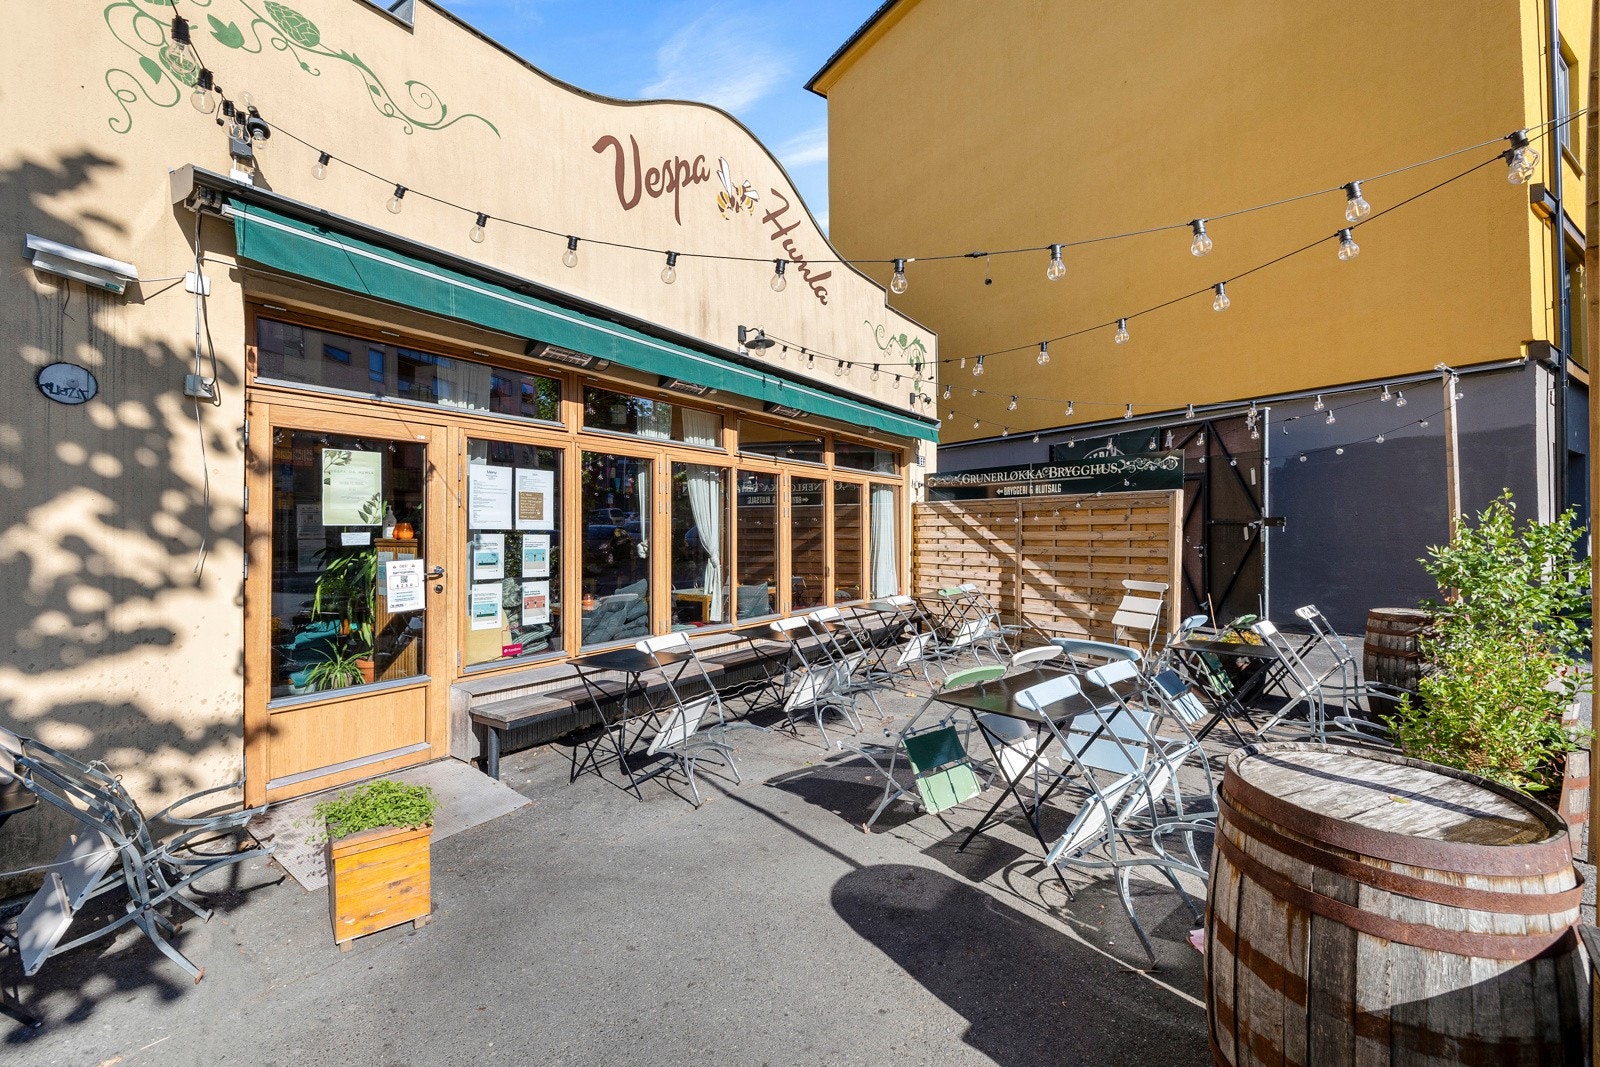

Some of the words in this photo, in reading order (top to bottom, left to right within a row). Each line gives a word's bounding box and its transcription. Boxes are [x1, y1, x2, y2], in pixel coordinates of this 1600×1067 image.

[592, 134, 711, 226] Vespa
[762, 188, 832, 306] Humla
[1049, 462, 1118, 479] BRYGGHUS
